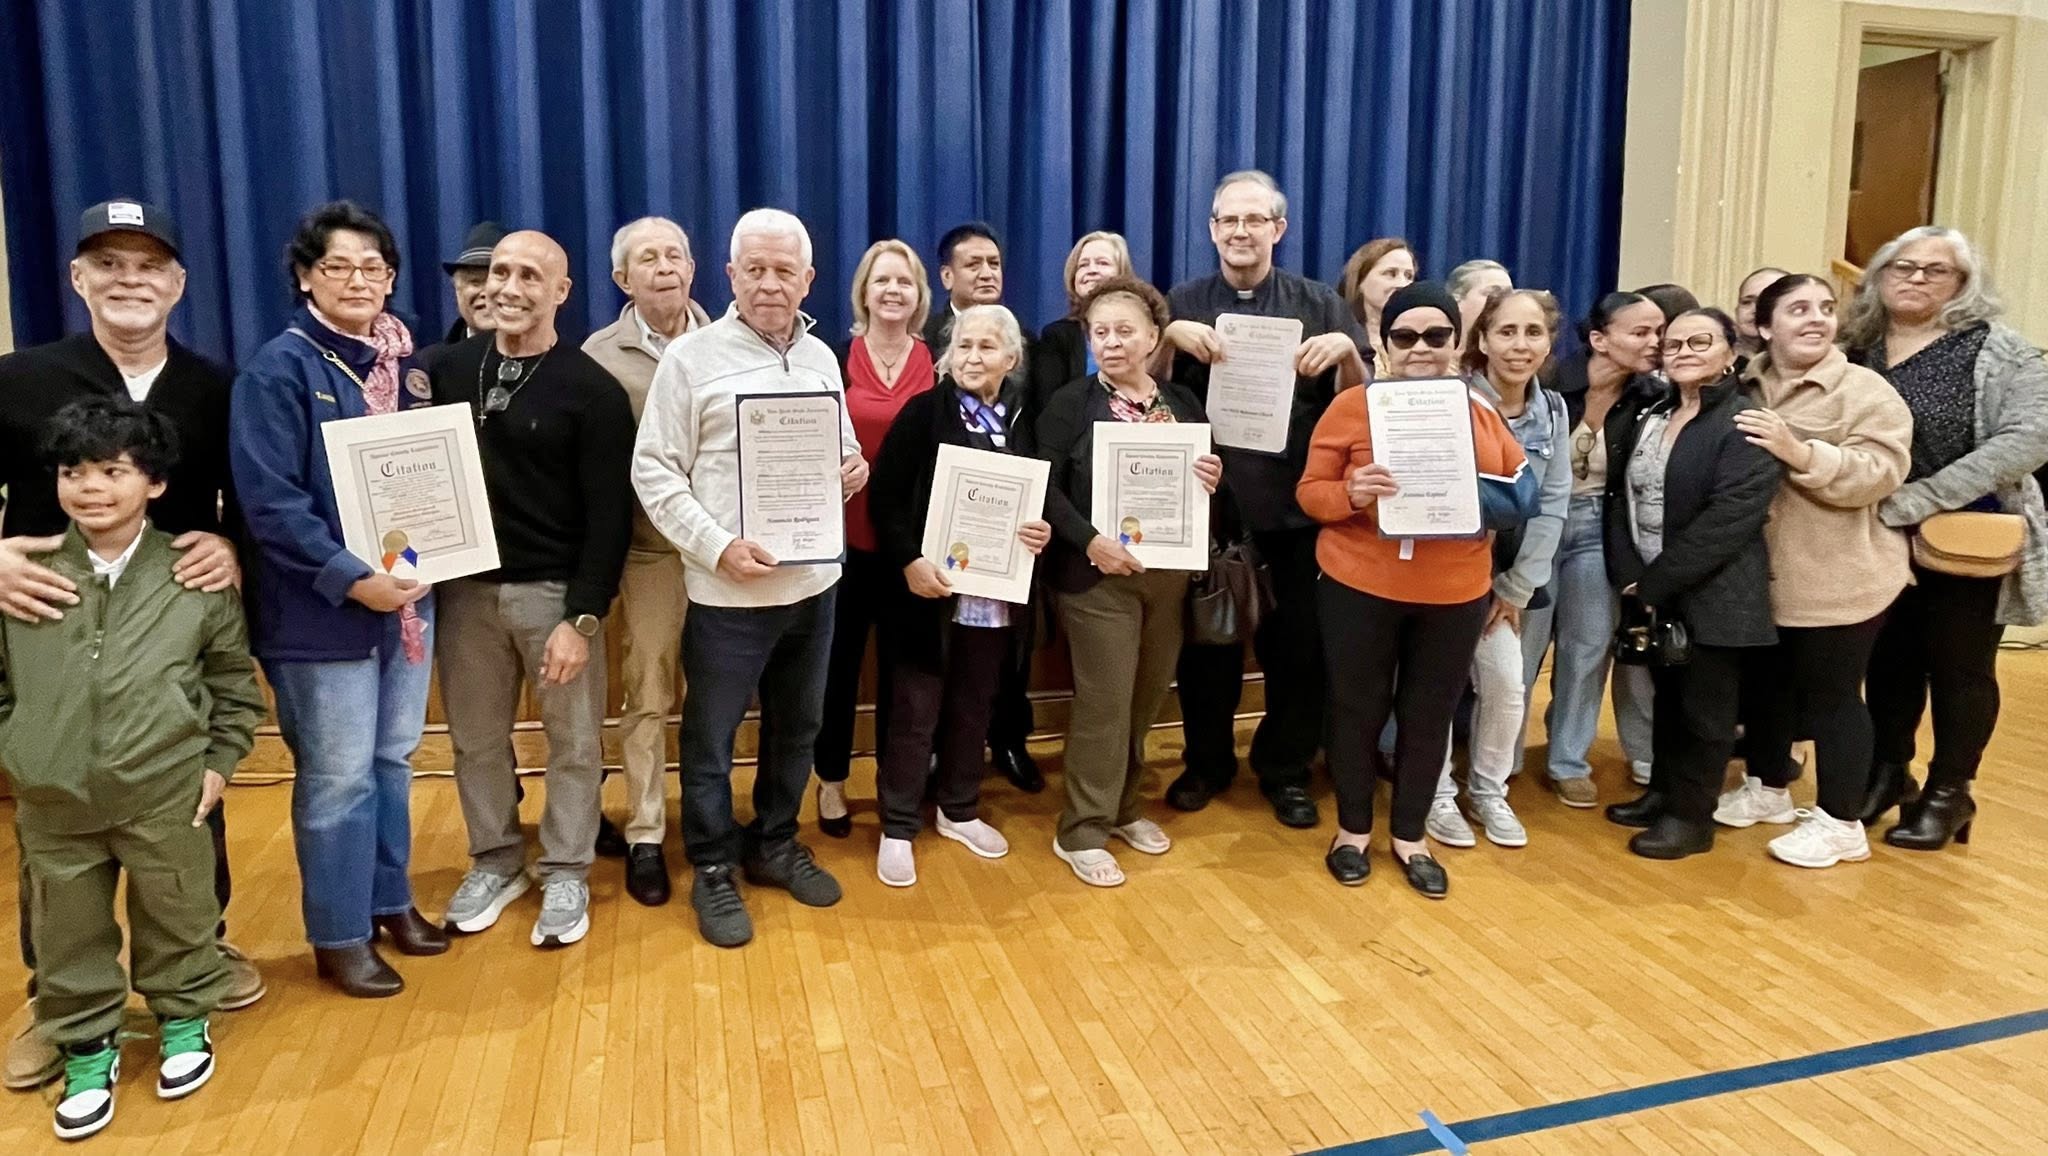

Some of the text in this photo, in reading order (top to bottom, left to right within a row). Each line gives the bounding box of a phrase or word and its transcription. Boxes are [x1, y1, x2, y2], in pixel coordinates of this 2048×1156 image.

[1408, 397, 1446, 406] Citation
[779, 416, 817, 426] Citation
[380, 460, 437, 478] Citation
[1130, 461, 1173, 476] Citation
[968, 487, 1009, 507] Citation
